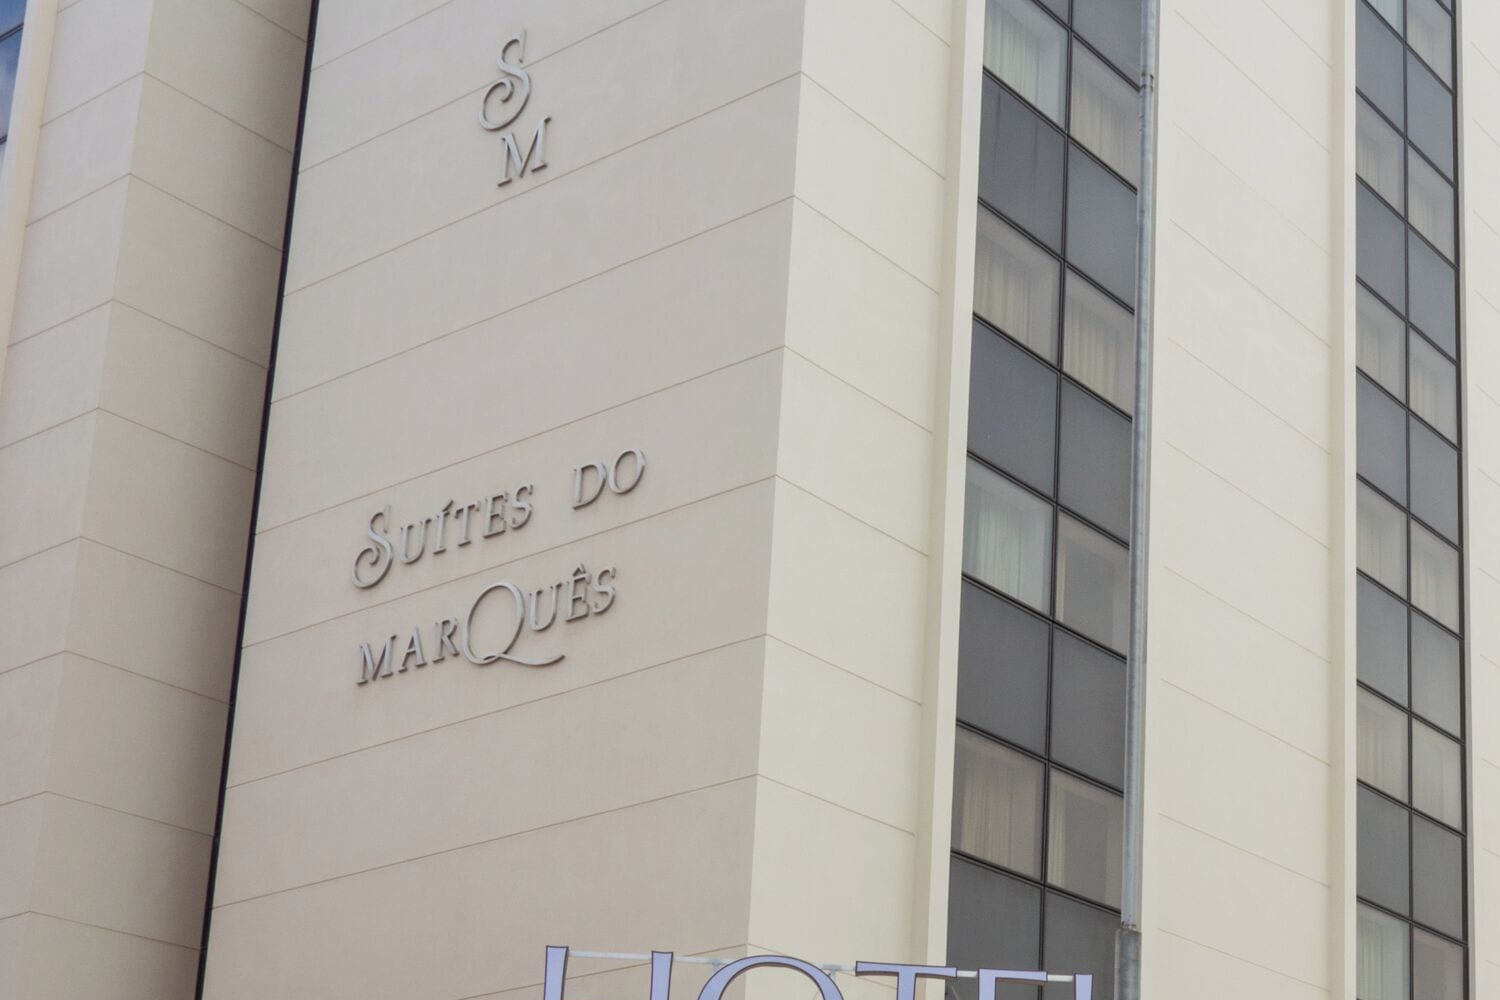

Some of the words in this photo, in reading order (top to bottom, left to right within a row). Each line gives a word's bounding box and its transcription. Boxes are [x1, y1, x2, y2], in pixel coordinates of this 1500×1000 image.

[477, 29, 533, 132] S
[496, 115, 551, 188] M
[572, 448, 646, 511] DO
